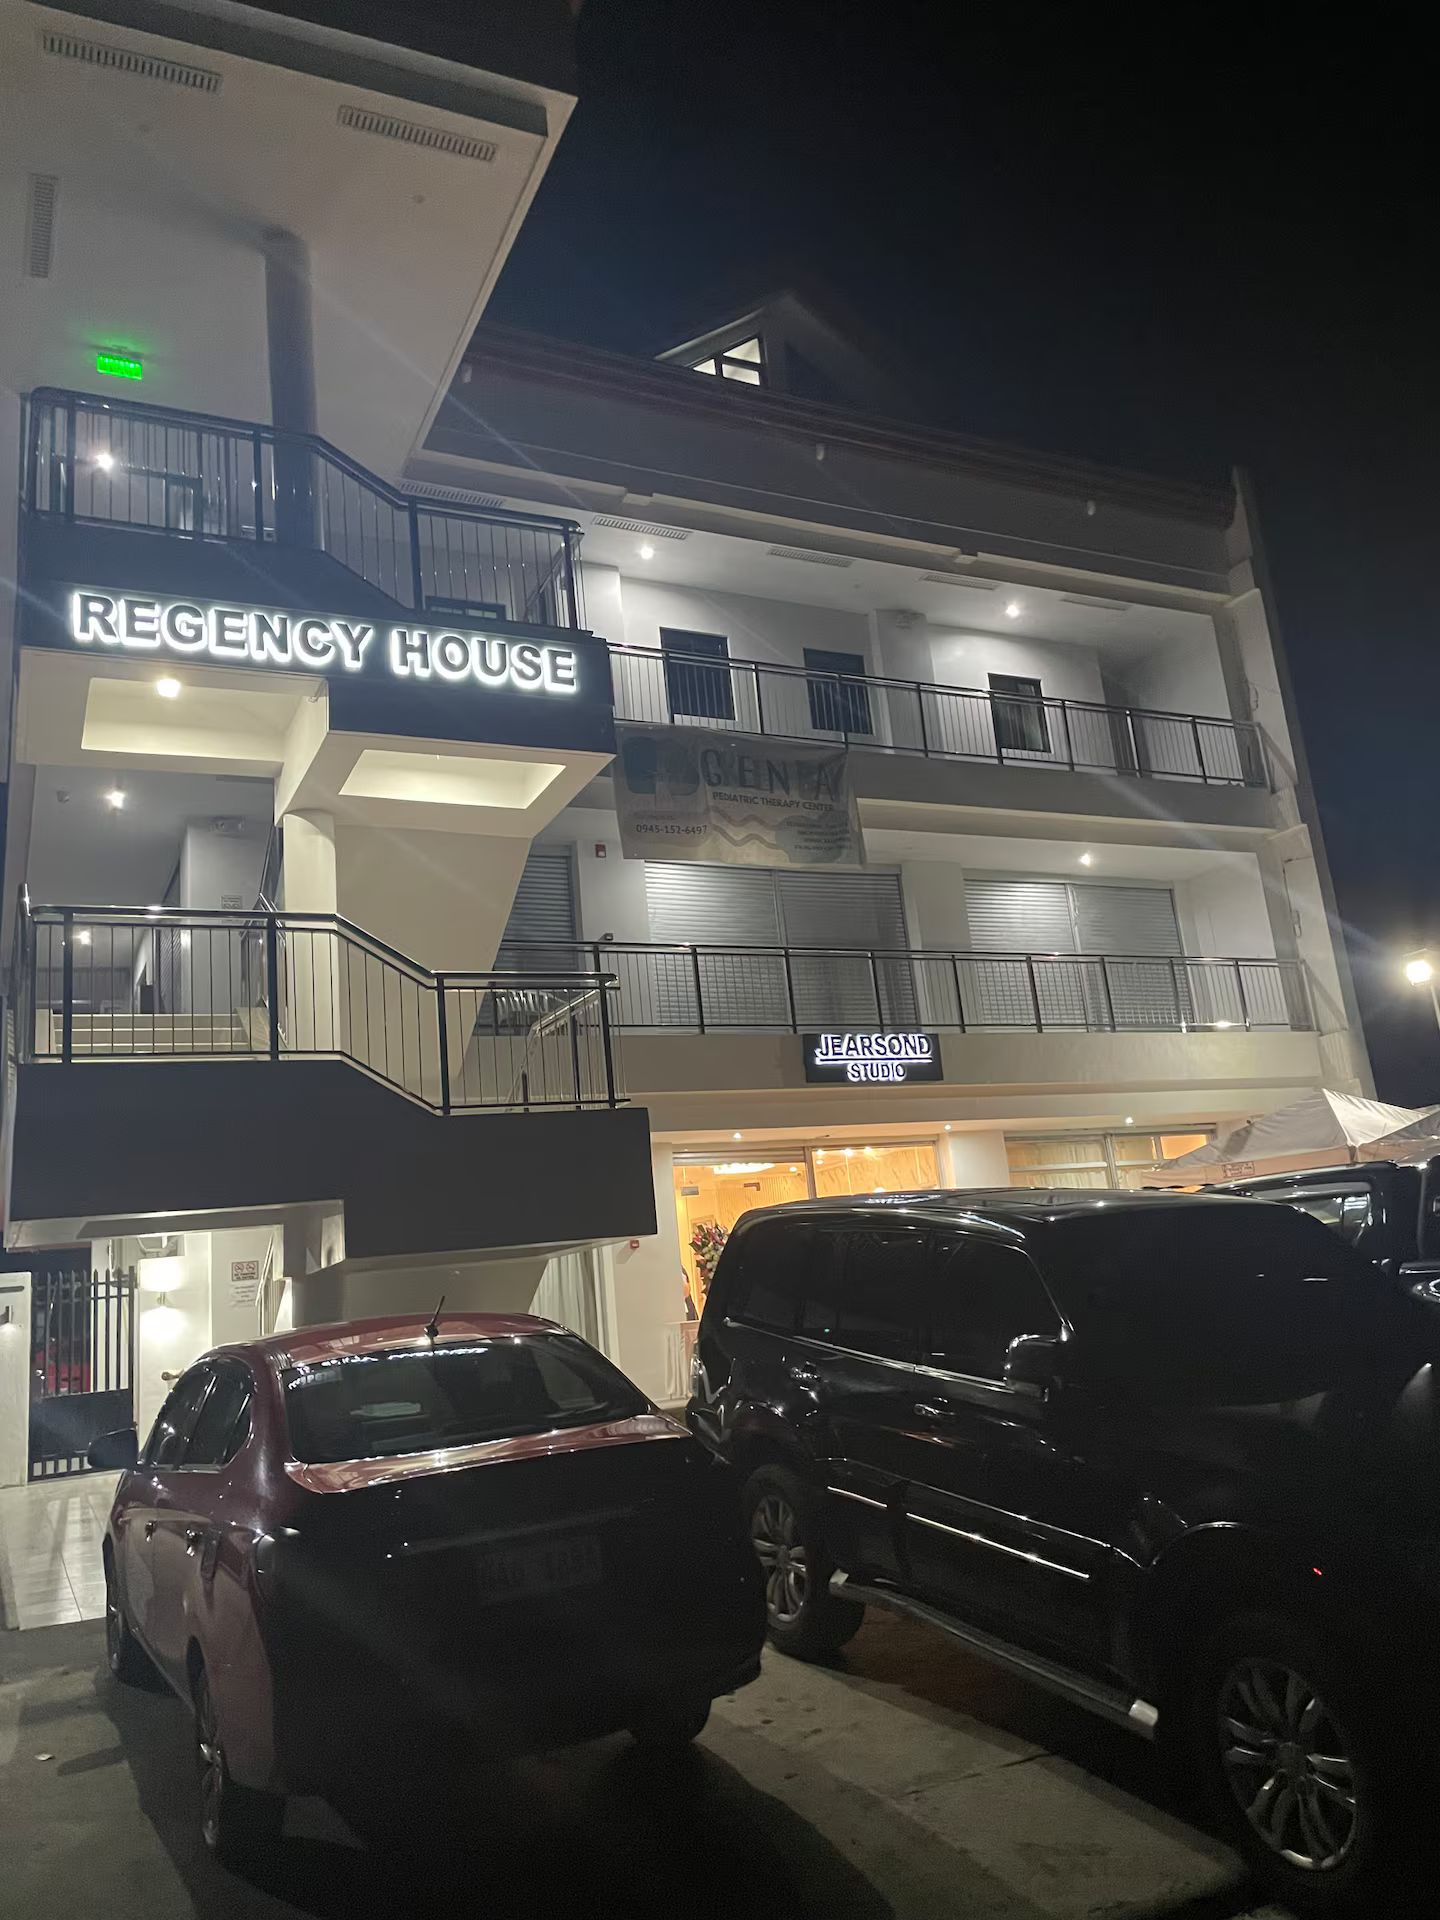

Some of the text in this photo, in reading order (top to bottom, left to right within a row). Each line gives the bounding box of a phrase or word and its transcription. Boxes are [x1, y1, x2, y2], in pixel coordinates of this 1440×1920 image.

[72, 589, 579, 694] REGENCY HOUSE
[712, 791, 835, 814] PEDIATRIC THERAPY CENTER
[635, 823, 708, 836] 0945-152-6497
[814, 1032, 933, 1057] JEARSOND
[846, 1063, 907, 1082] STUDIO
